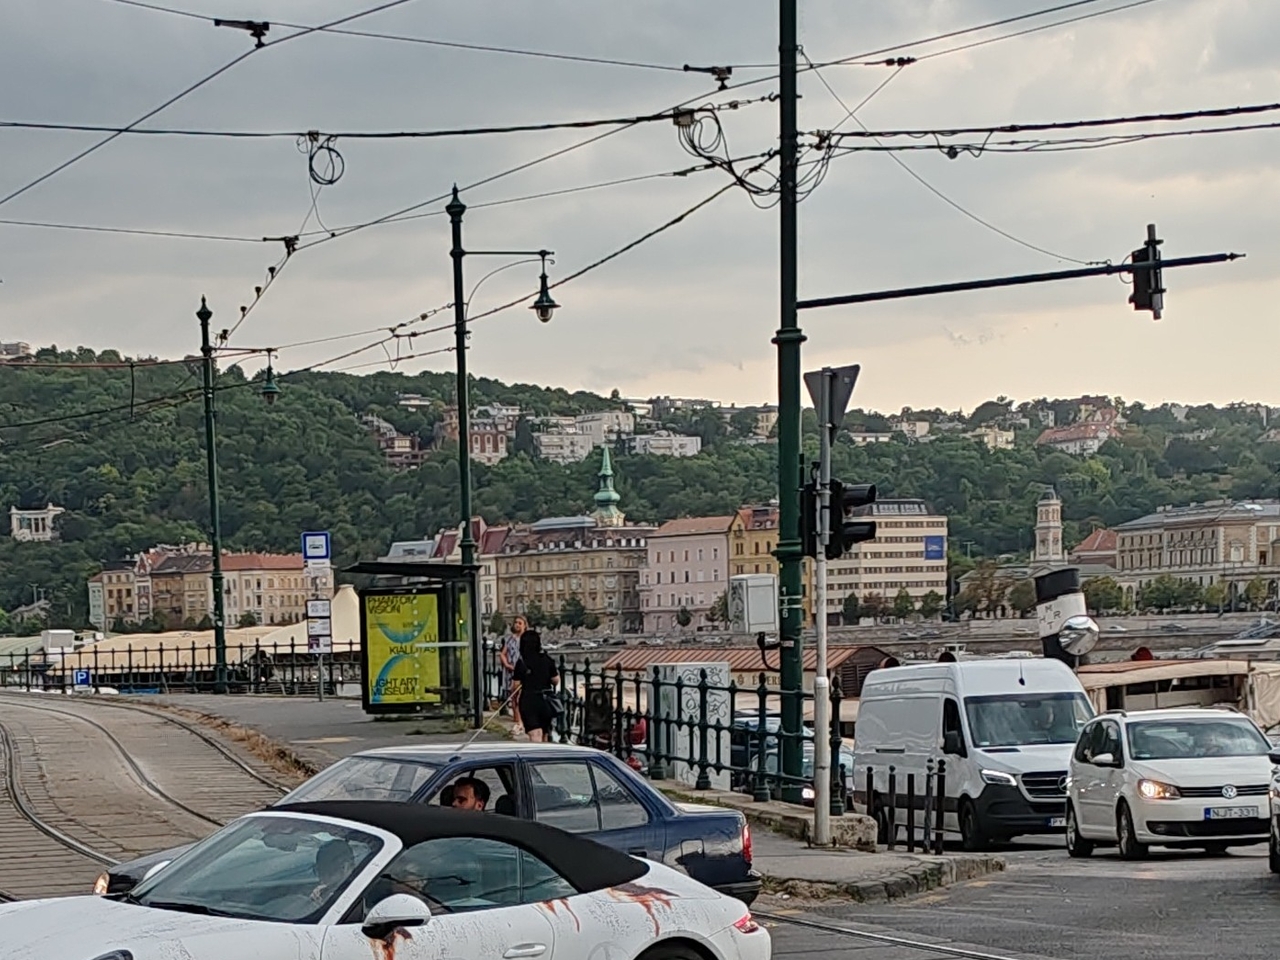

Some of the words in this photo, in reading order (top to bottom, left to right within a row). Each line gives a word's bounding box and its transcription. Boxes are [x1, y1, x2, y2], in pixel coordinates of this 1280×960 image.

[368, 596, 417, 604] PHANTOM
[368, 605, 401, 614] VISION
[77, 672, 87, 684] P
[370, 678, 398, 688] LIGHT
[400, 677, 418, 686] ART
[371, 686, 416, 696] MUSEUM
